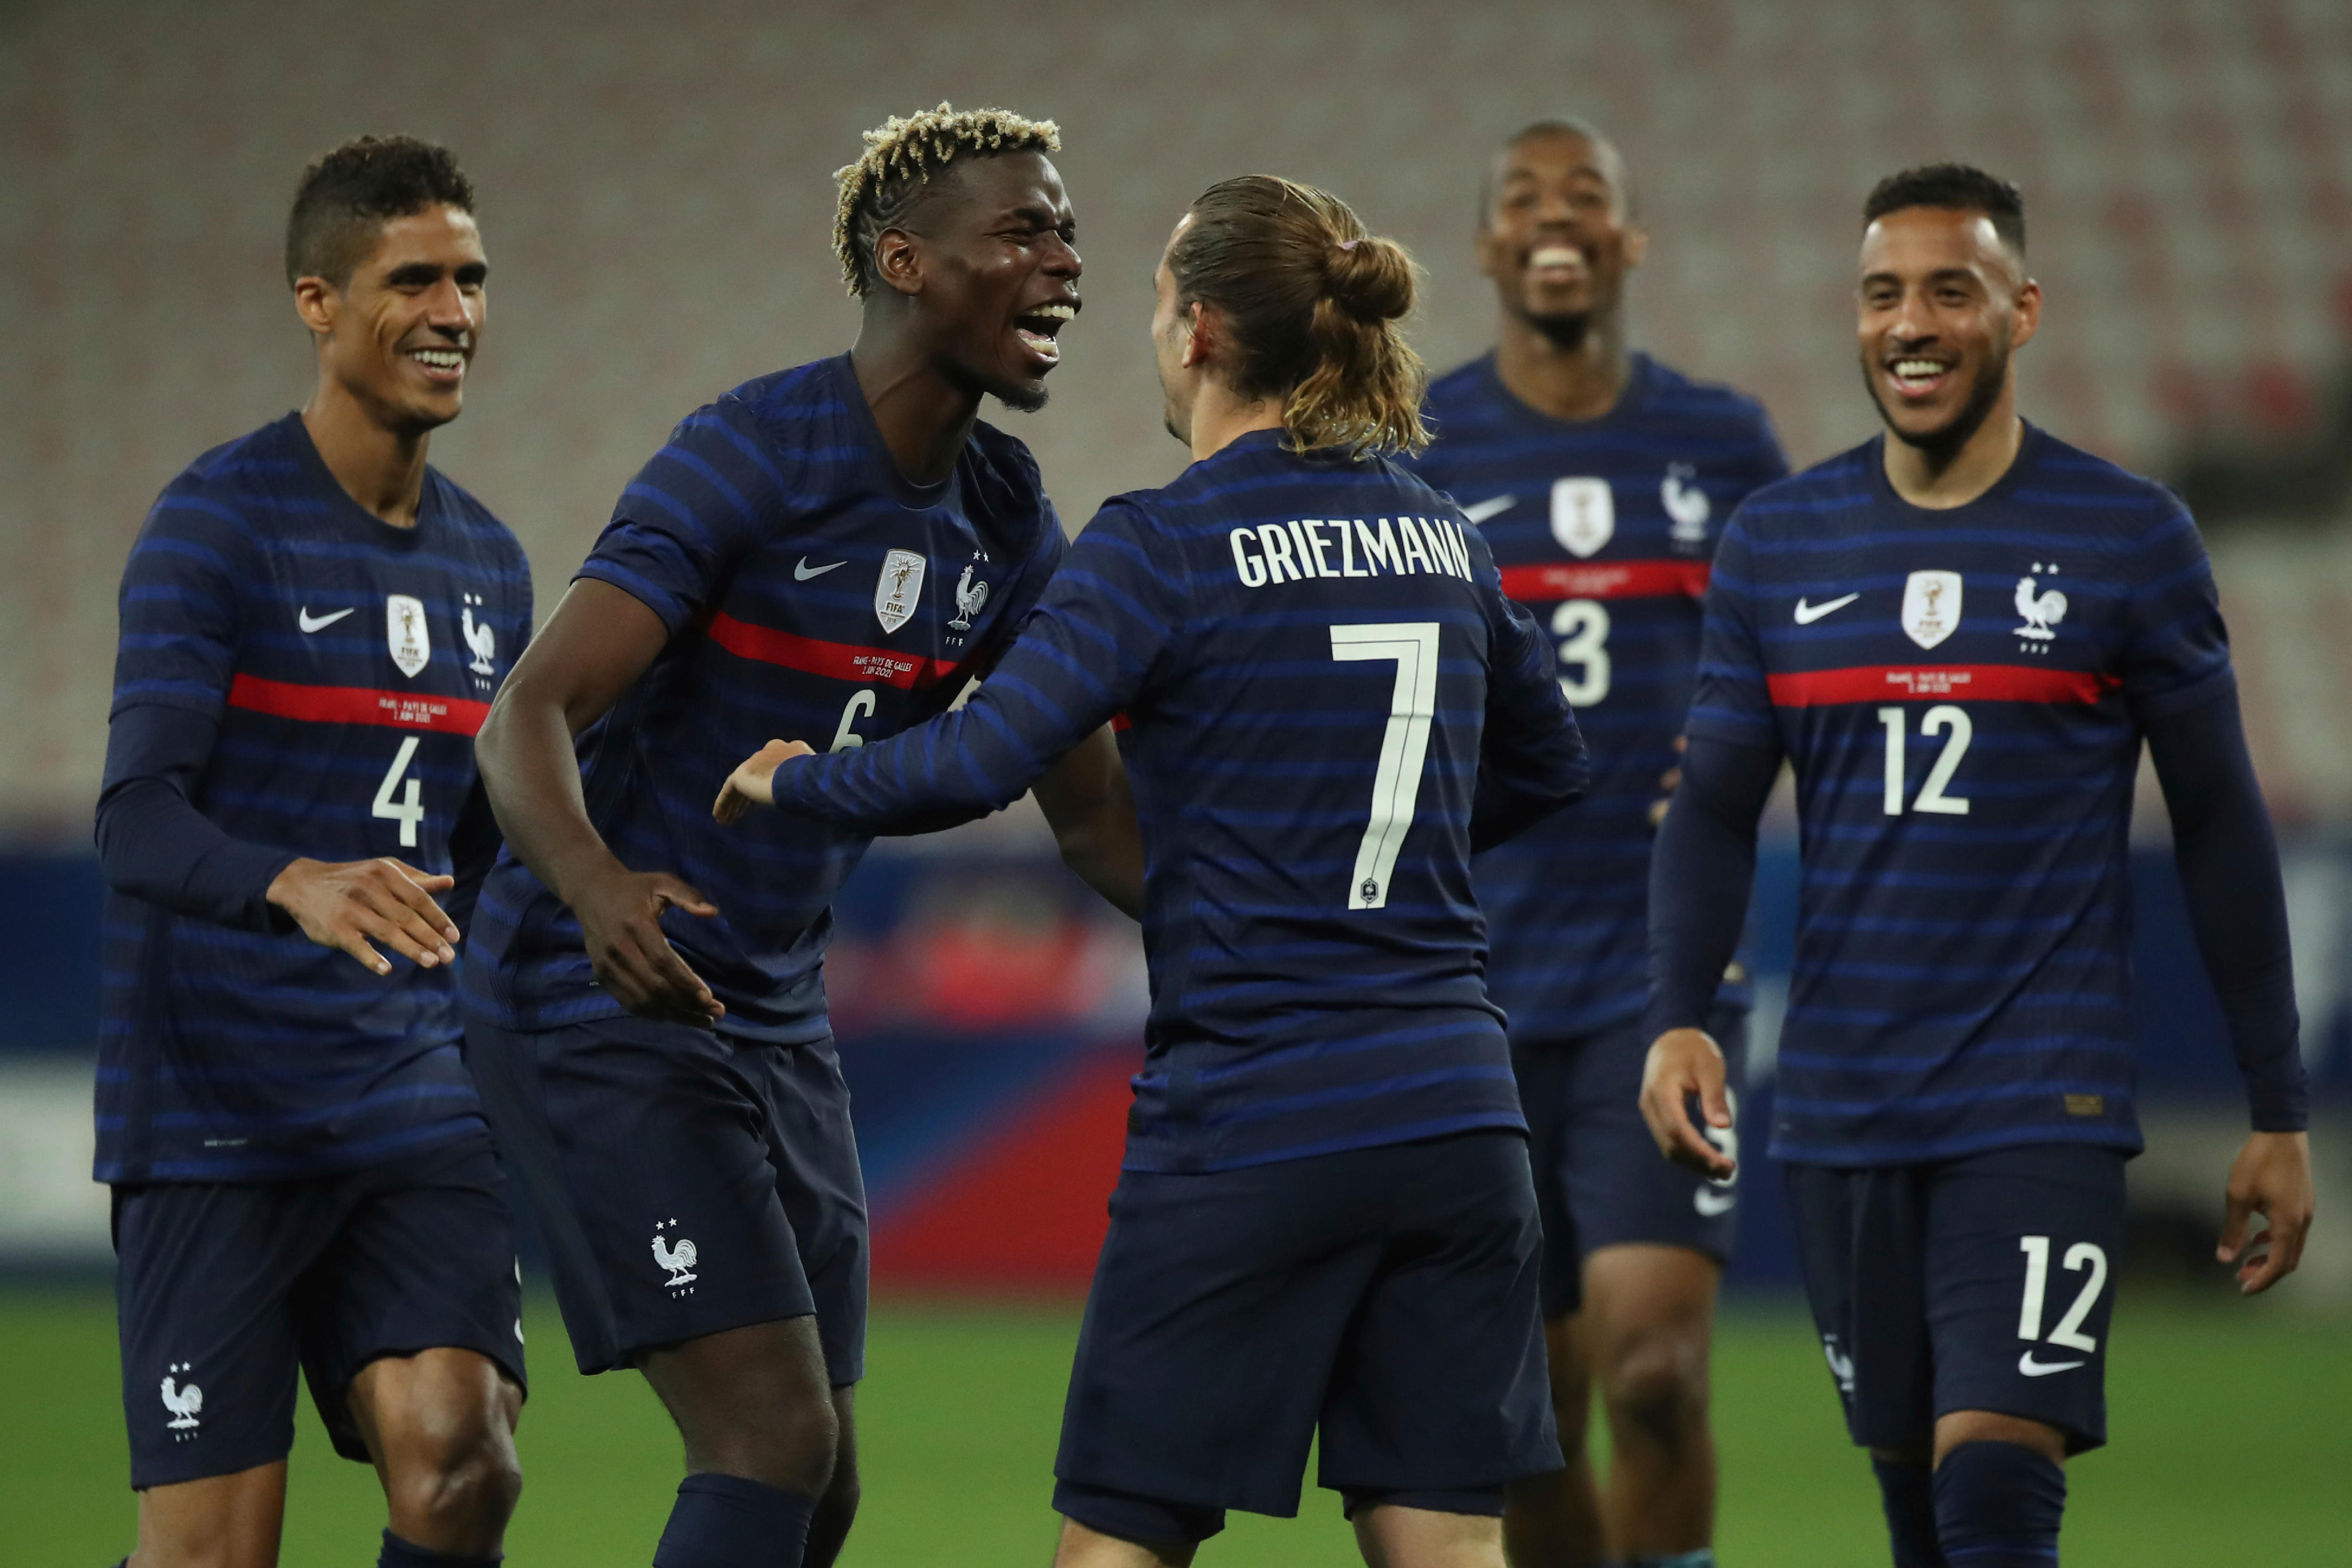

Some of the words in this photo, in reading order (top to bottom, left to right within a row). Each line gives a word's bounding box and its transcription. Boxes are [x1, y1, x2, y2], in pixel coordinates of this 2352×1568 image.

[1230, 516, 1473, 588] GRIEZMANN
[875, 667, 893, 678] 2021
[894, 661, 913, 672] GALLES
[1551, 598, 1611, 708] 3
[372, 736, 424, 847] 4
[1329, 622, 1440, 910] 7
[1877, 705, 1972, 815] 12
[2018, 1235, 2108, 1353] 12
